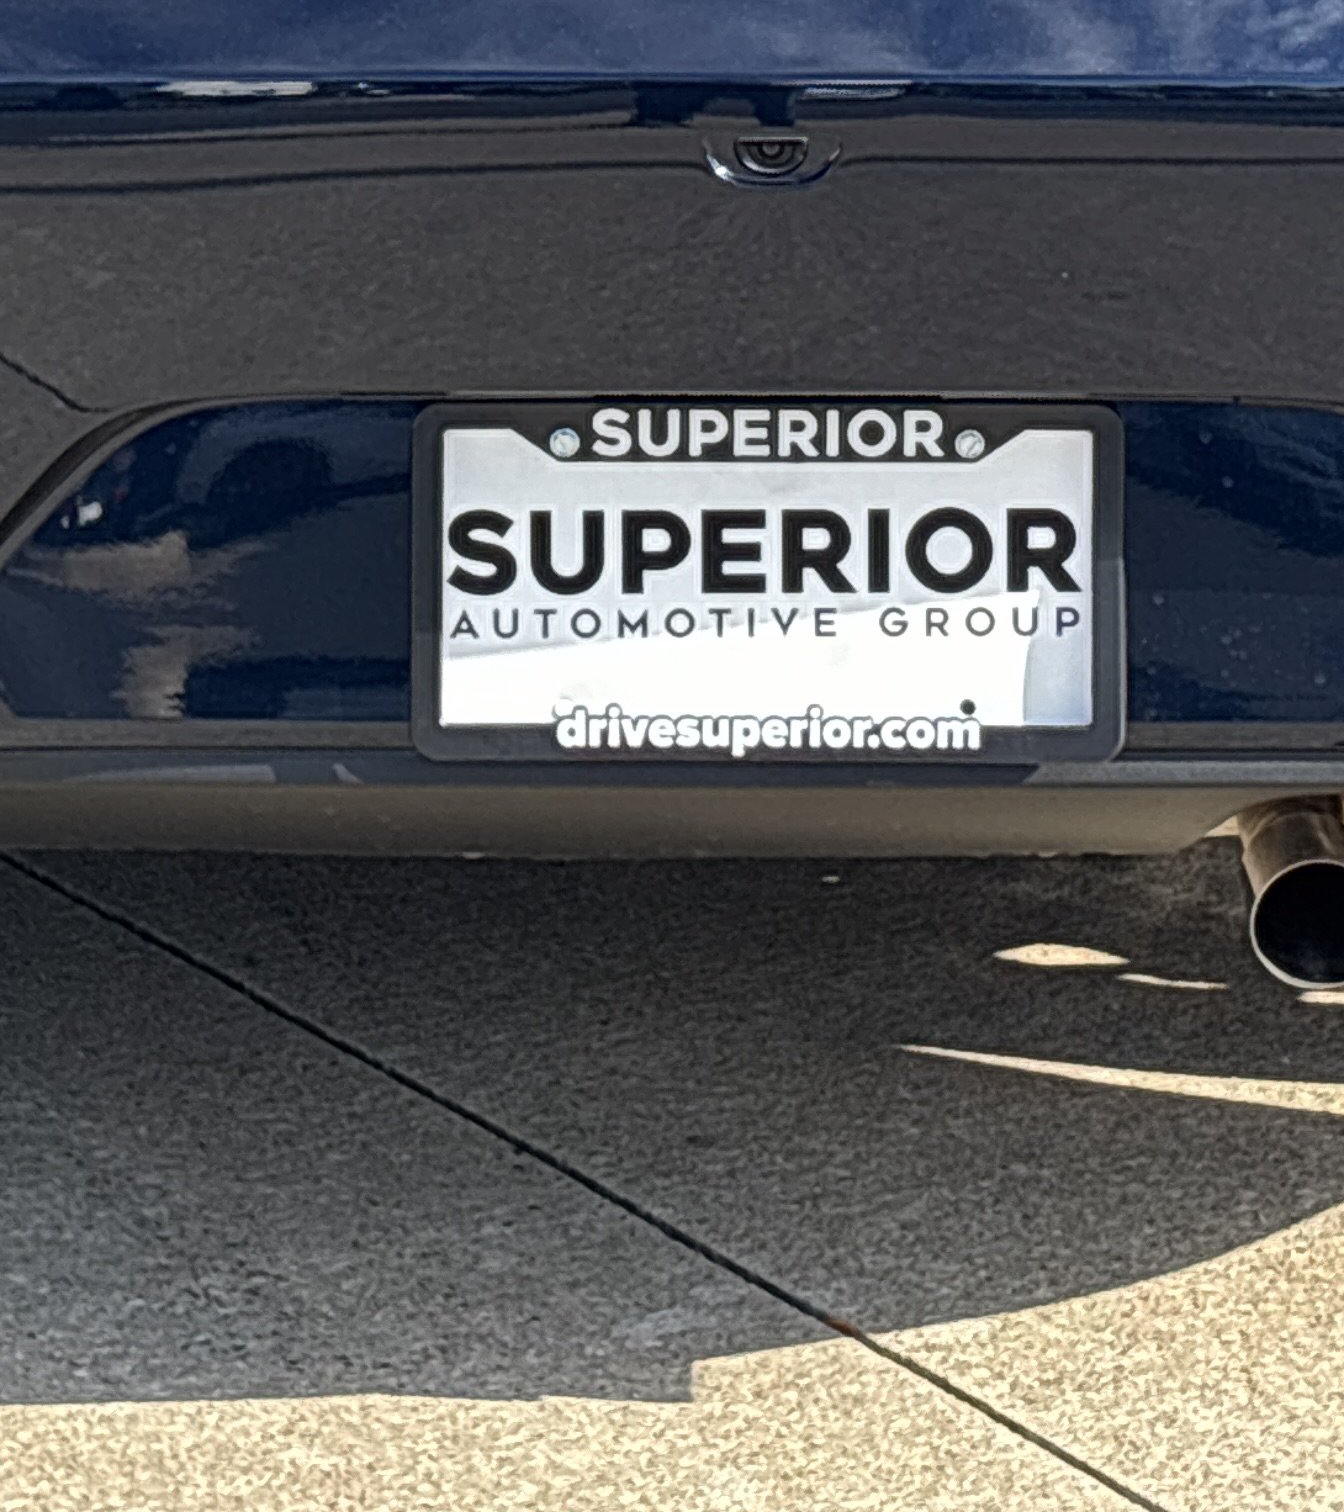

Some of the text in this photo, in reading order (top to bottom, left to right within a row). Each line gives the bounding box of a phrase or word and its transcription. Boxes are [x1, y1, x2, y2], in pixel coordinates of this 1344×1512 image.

[591, 408, 945, 458] SUPERIOR
[446, 507, 1082, 596] SUPERIOR
[450, 606, 1081, 639] AUTOMOTIVE GROUP
[555, 704, 982, 758] drivesuperior.com
